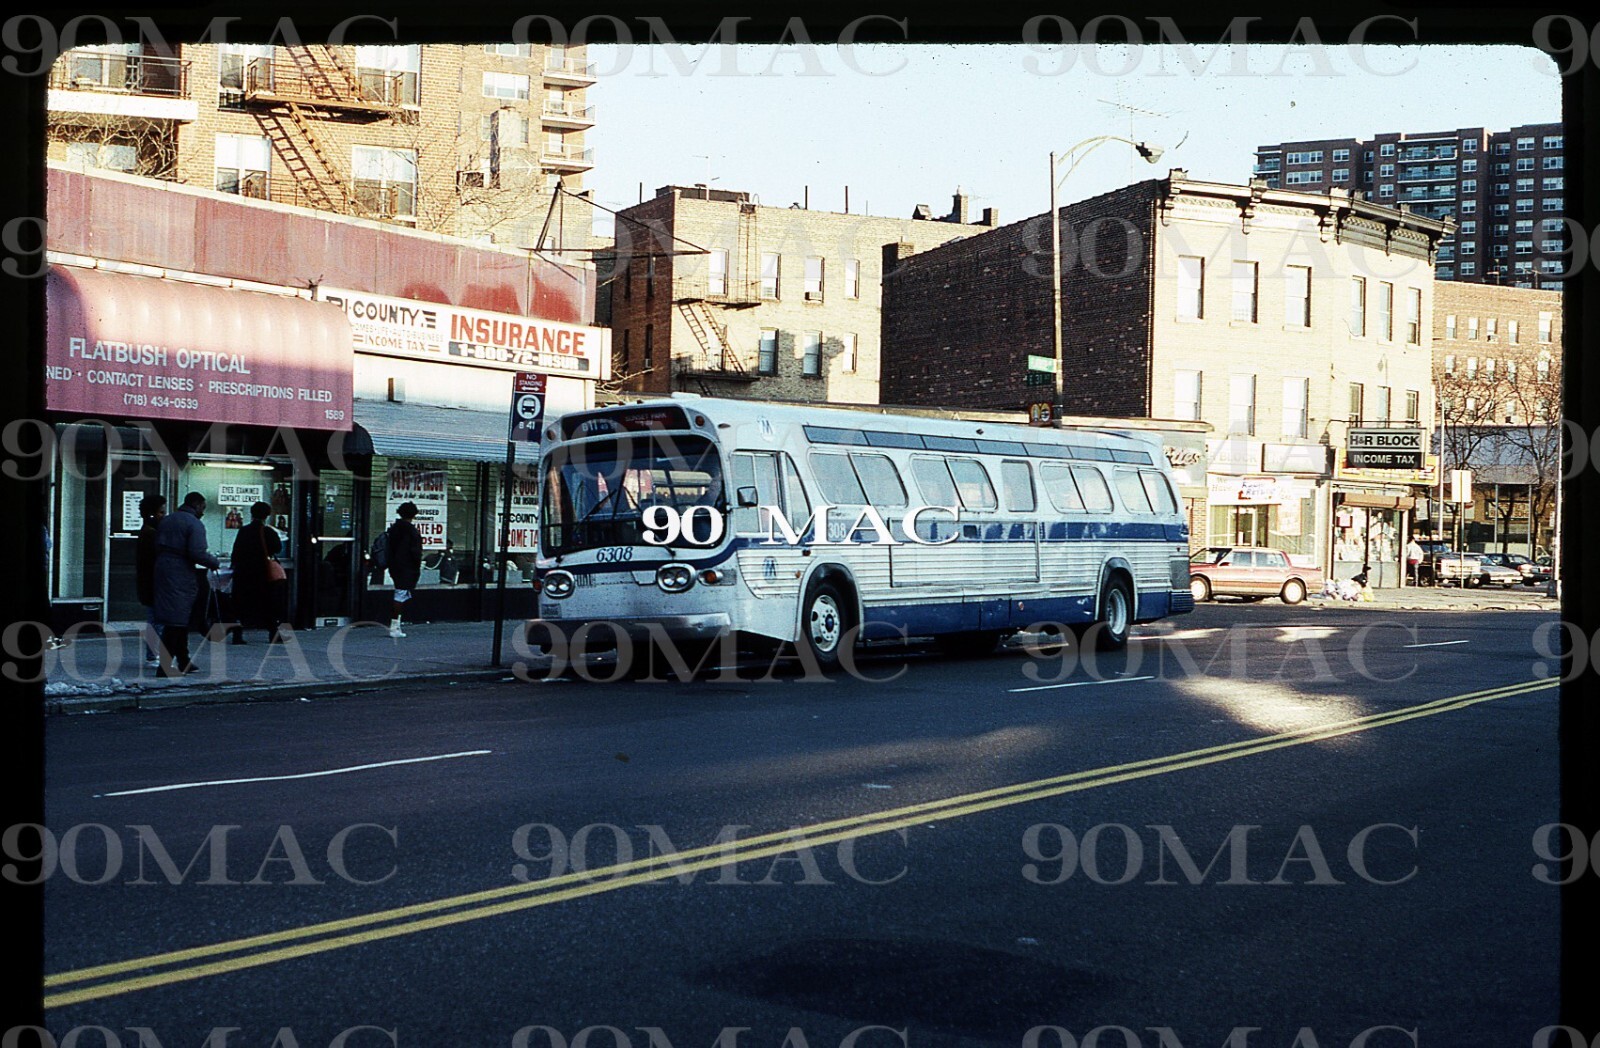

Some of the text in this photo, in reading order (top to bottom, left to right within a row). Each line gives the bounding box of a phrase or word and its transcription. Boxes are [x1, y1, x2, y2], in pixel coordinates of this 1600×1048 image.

[450, 314, 585, 356] INSURANCE
[364, 335, 425, 352] INCOME TAX
[69, 337, 250, 374] FLATBUSH OPTICAL
[87, 370, 144, 387] CONTACT
[148, 375, 194, 392] LENSES
[208, 381, 293, 400] PRESCRIPTIONS
[298, 387, 332, 402] FILLED
[123, 393, 198, 410] (718) 434-0539
[324, 409, 344, 420] 1589
[526, 421, 535, 430] 41
[1350, 434, 1420, 447] H&R BLOCK
[1353, 454, 1415, 465] INCOME TAX
[222, 486, 259, 494] EYES EXAMINED
[220, 494, 261, 503] CONTACT LENSES
[596, 545, 633, 562] 6308
